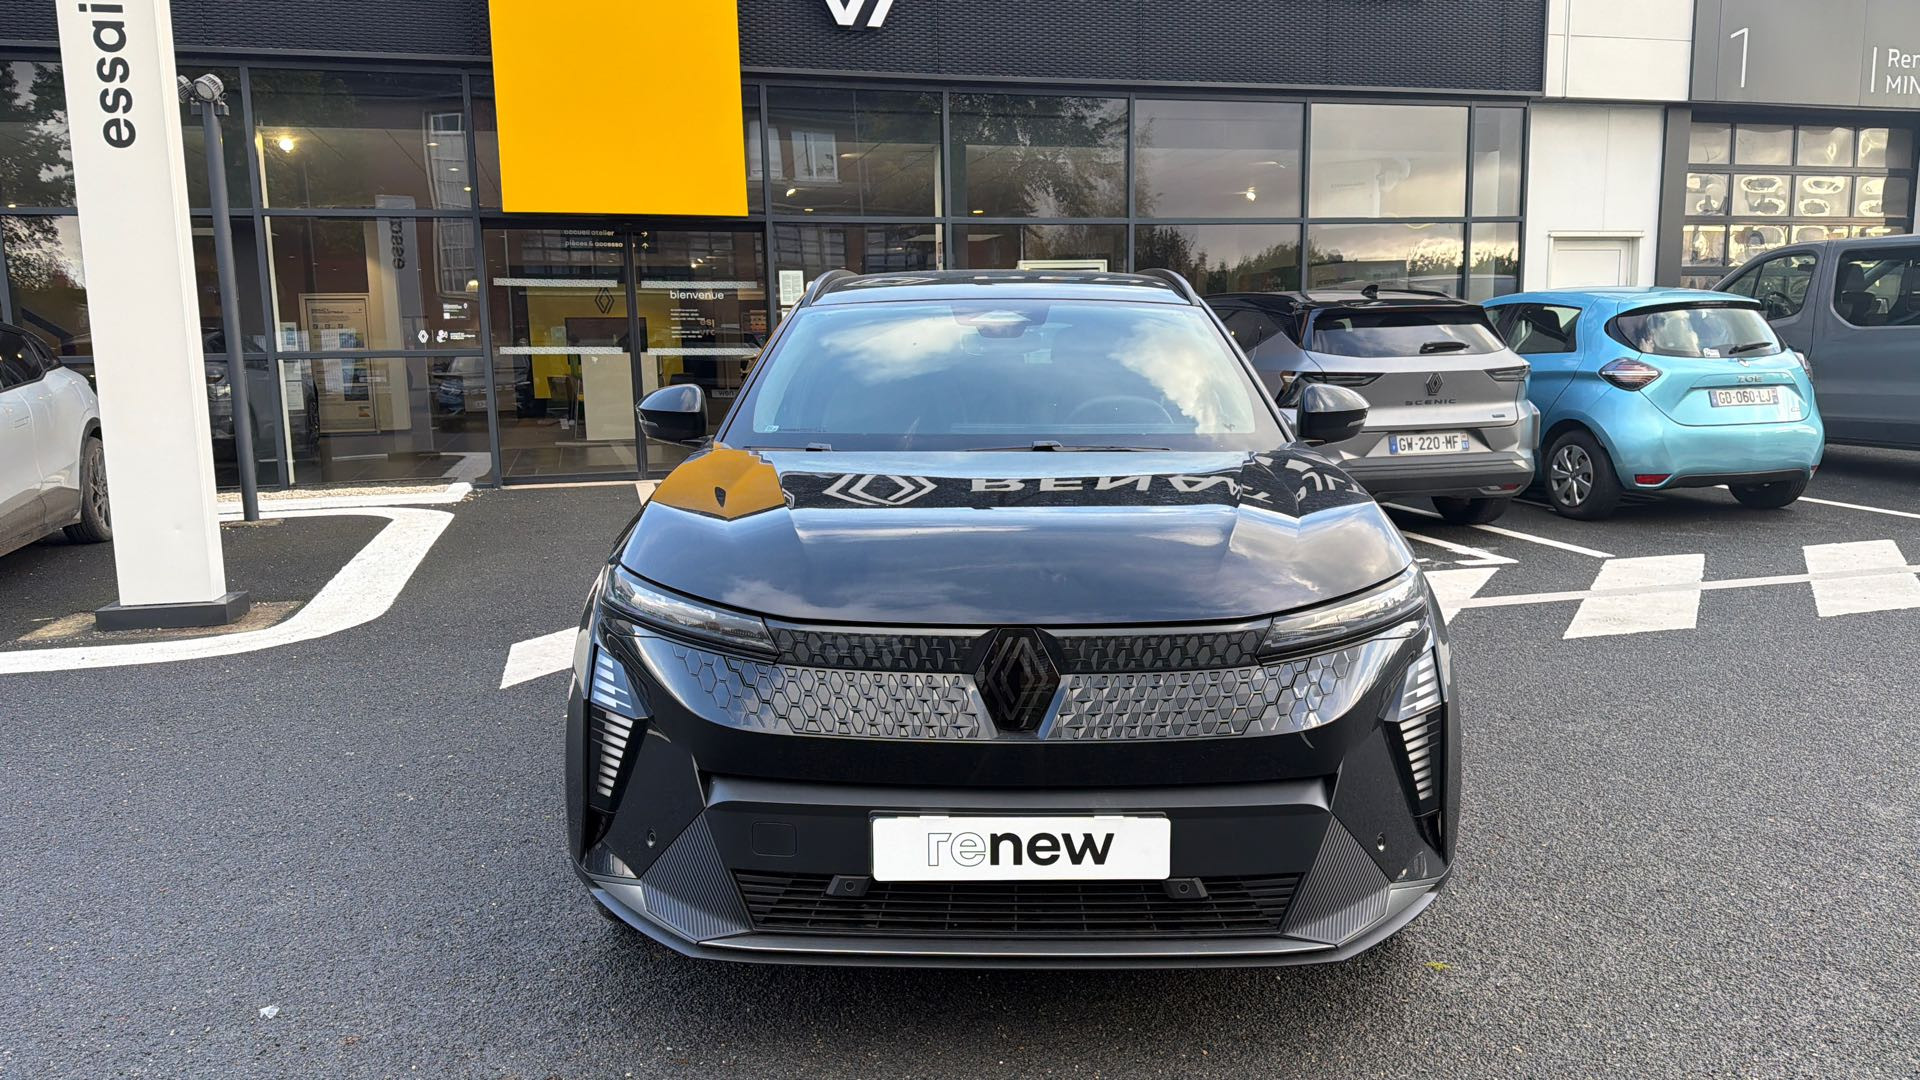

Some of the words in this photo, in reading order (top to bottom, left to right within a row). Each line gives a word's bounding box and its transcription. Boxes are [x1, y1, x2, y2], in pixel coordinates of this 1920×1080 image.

[78, 3, 136, 149] essai
[670, 290, 724, 299] bienvenue
[1399, 435, 1458, 451] GW-220-MF
[928, 831, 1115, 867] renew
